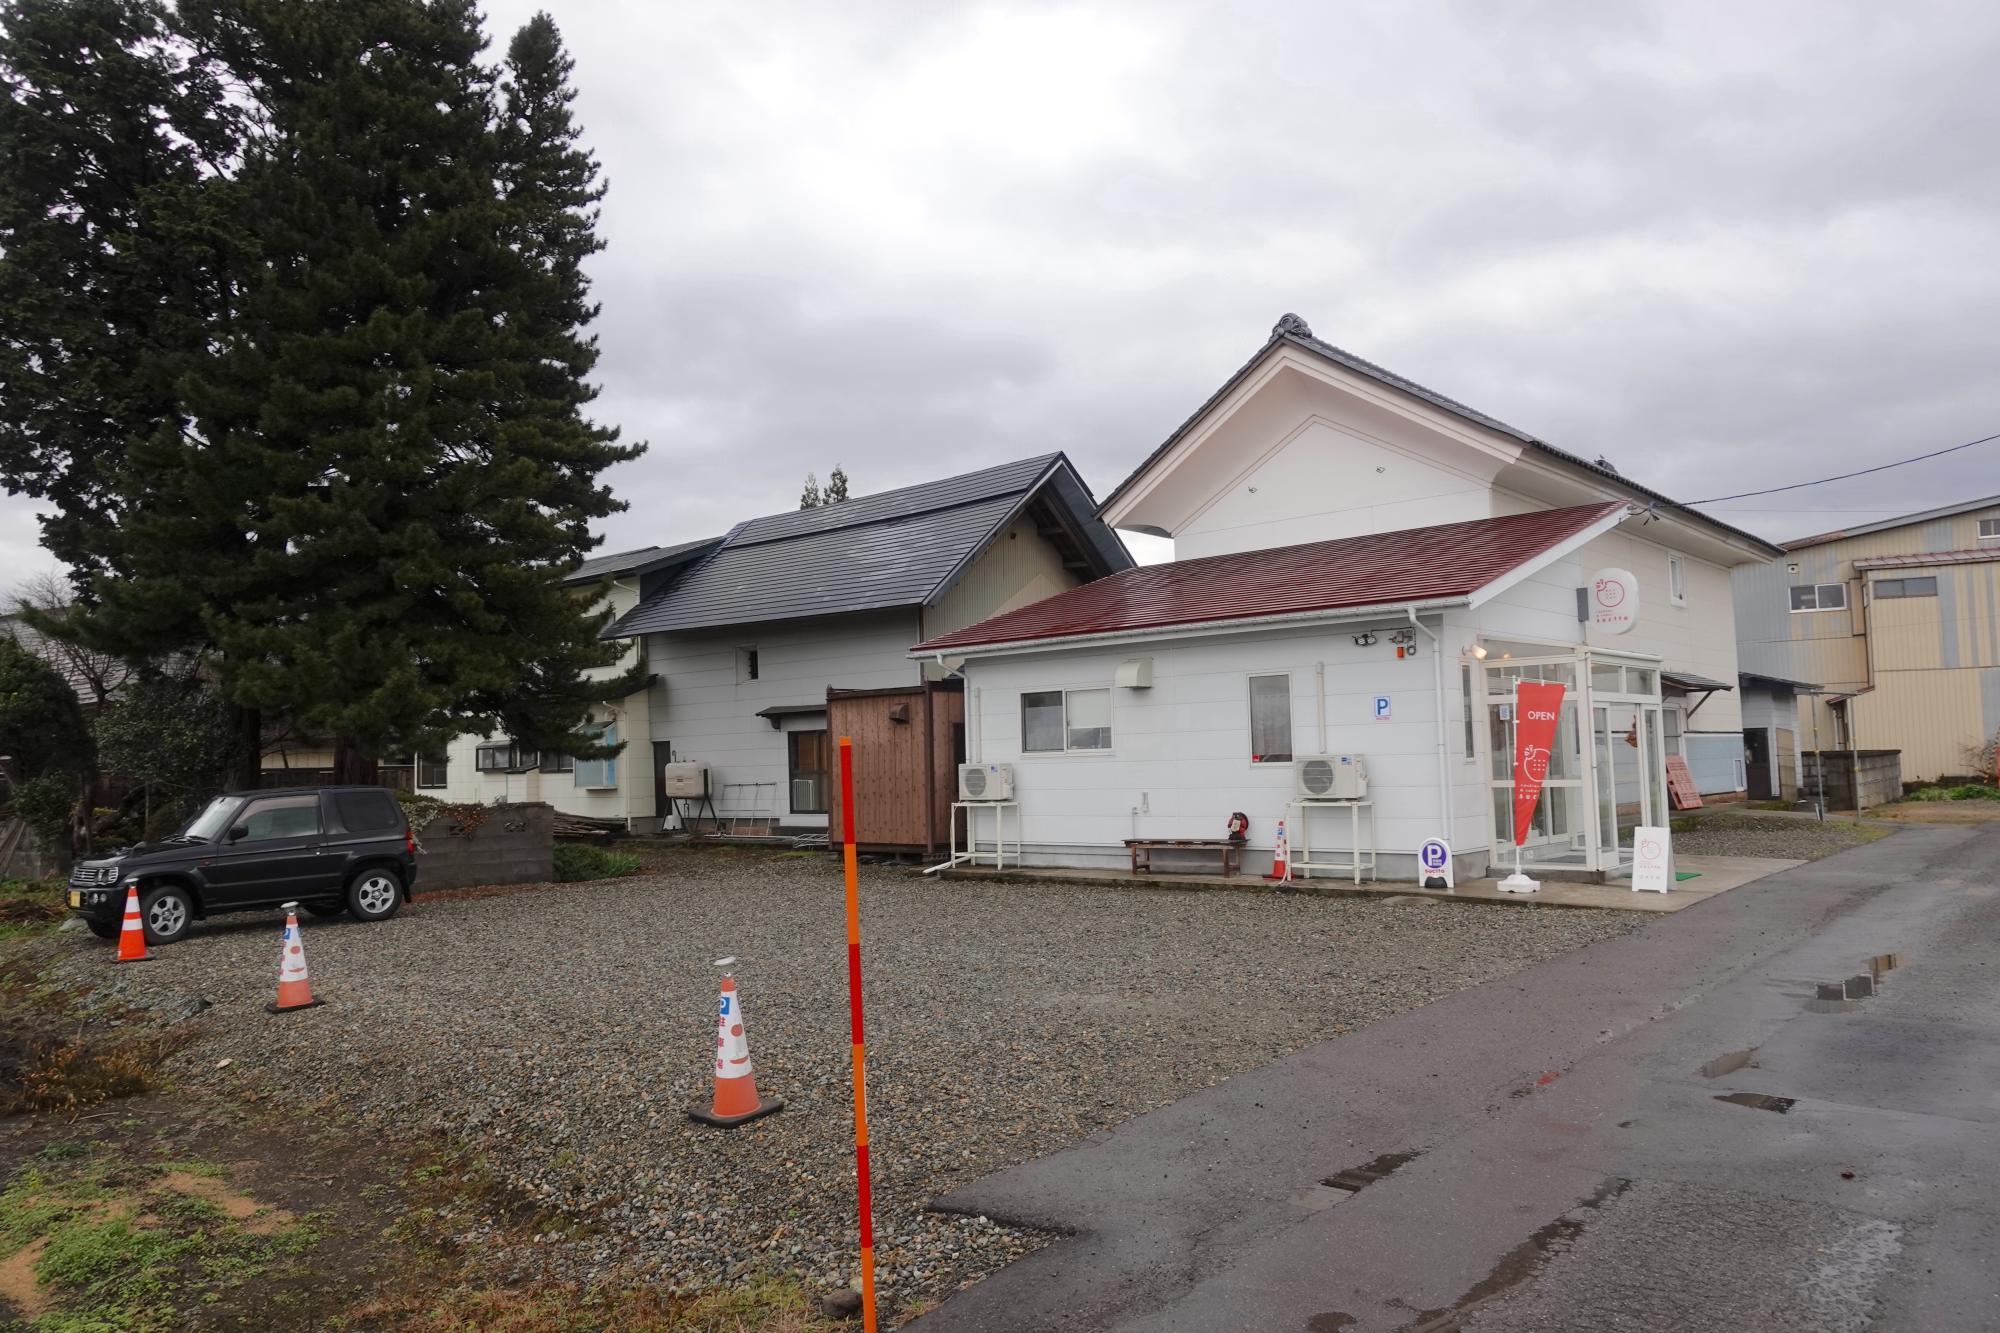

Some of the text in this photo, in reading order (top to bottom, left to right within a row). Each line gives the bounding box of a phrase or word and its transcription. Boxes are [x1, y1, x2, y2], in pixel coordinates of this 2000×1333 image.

[1377, 699, 1388, 715] P
[1528, 711, 1555, 720] OPEN
[1427, 845, 1442, 866] P
